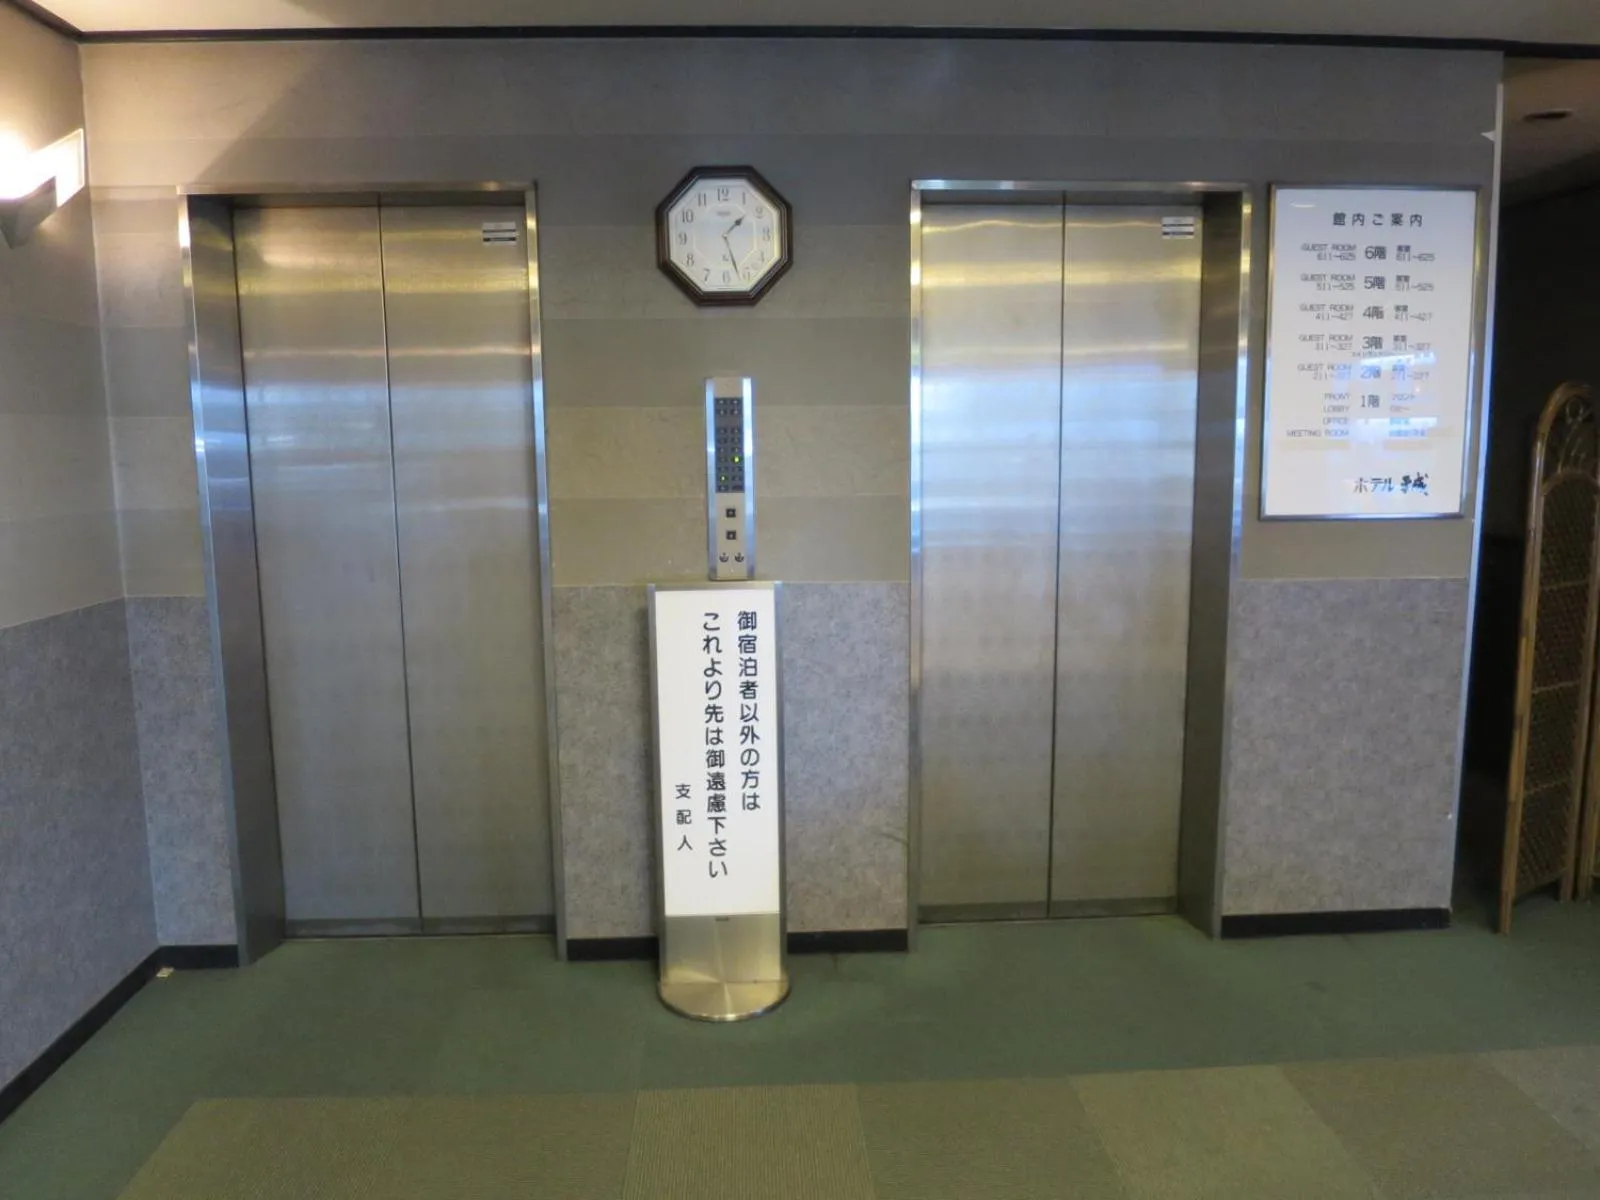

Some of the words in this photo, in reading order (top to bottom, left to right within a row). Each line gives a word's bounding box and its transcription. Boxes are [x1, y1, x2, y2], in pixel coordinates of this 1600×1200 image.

[697, 192, 707, 206] 11
[717, 188, 730, 202] 12
[682, 208, 694, 223] 10
[755, 206, 765, 219] 2
[1332, 212, 1423, 228] 館内ご案内
[678, 232, 688, 245] 9
[762, 227, 771, 242] 3
[1301, 243, 1327, 251] GUEST
[1331, 243, 1357, 251] ROOM
[1364, 246, 1387, 260] 6階
[686, 253, 695, 266] 8
[703, 268, 711, 282] 7
[722, 271, 731, 283] 6
[1300, 273, 1326, 281] GUEST
[1330, 273, 1355, 281] ROOM
[1363, 275, 1386, 290] 5階
[1299, 303, 1325, 312] GUEST
[1329, 303, 1354, 312] ROOM
[1362, 305, 1385, 320] 4階
[1298, 334, 1325, 342] GUEST
[1328, 334, 1353, 342] ROOM
[1362, 335, 1384, 350] 3階
[1360, 394, 1381, 409] 1階
[1286, 429, 1321, 437] MEETING
[1353, 476, 1394, 493] ホテル
[737, 611, 761, 811] 御宿泊者以外の方は
[702, 612, 728, 878] これより先は御遠慮下さい
[675, 783, 693, 851] 支配人
